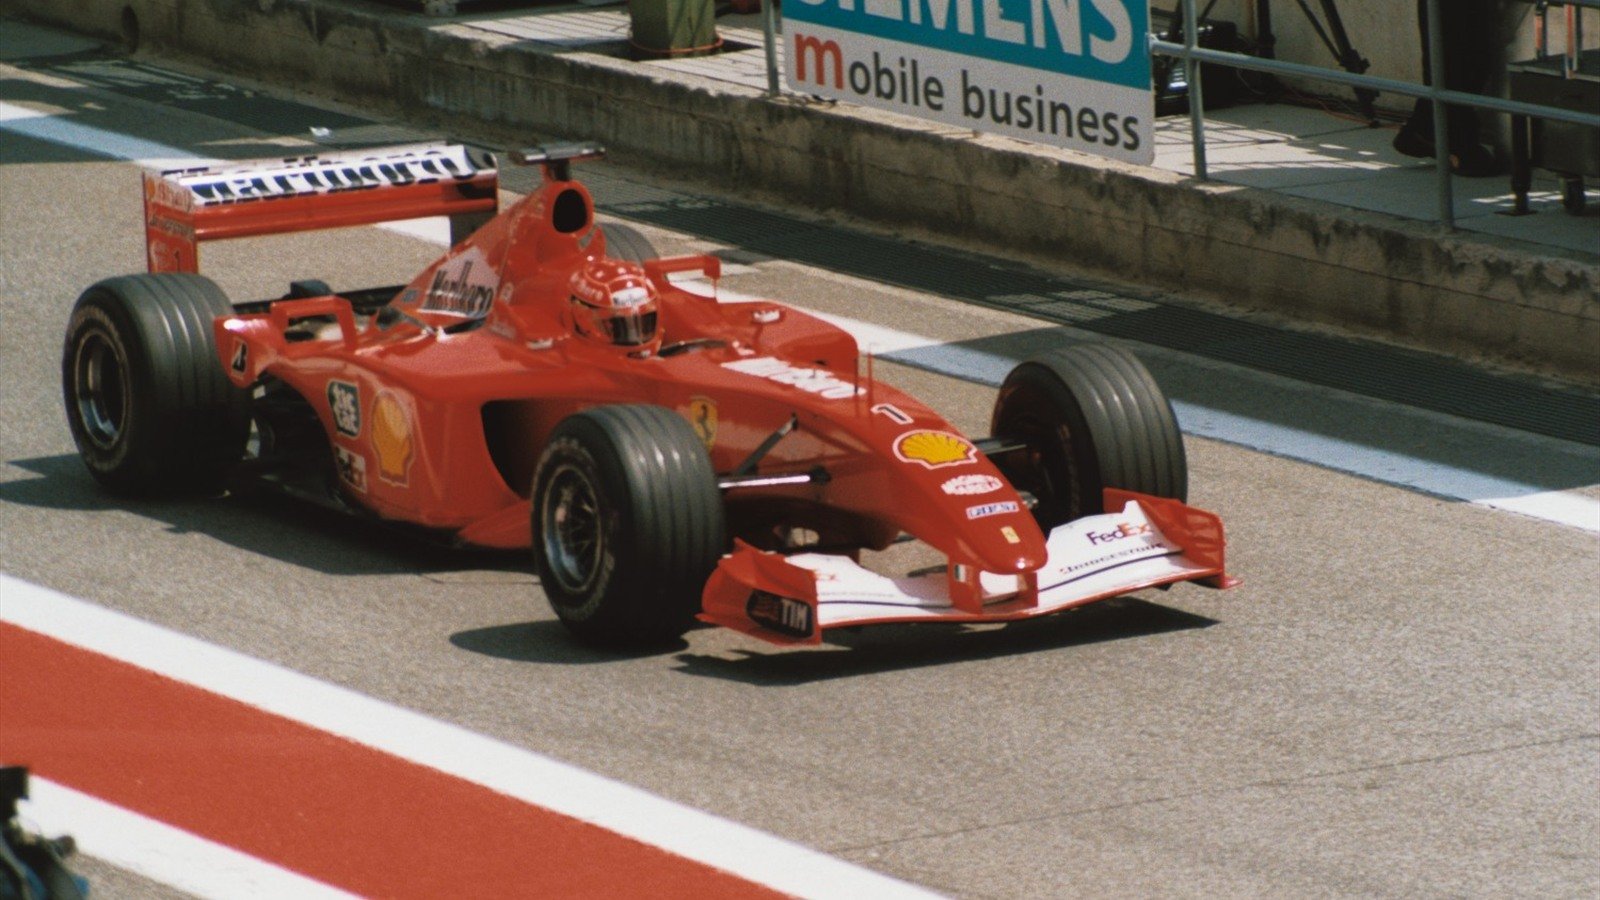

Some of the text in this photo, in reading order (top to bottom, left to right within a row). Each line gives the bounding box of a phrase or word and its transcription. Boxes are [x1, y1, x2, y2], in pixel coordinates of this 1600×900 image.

[794, 31, 1141, 151] mobile business
[871, 403, 913, 425] 1
[1085, 522, 1153, 546] FedEx
[781, 598, 809, 631] TIM
